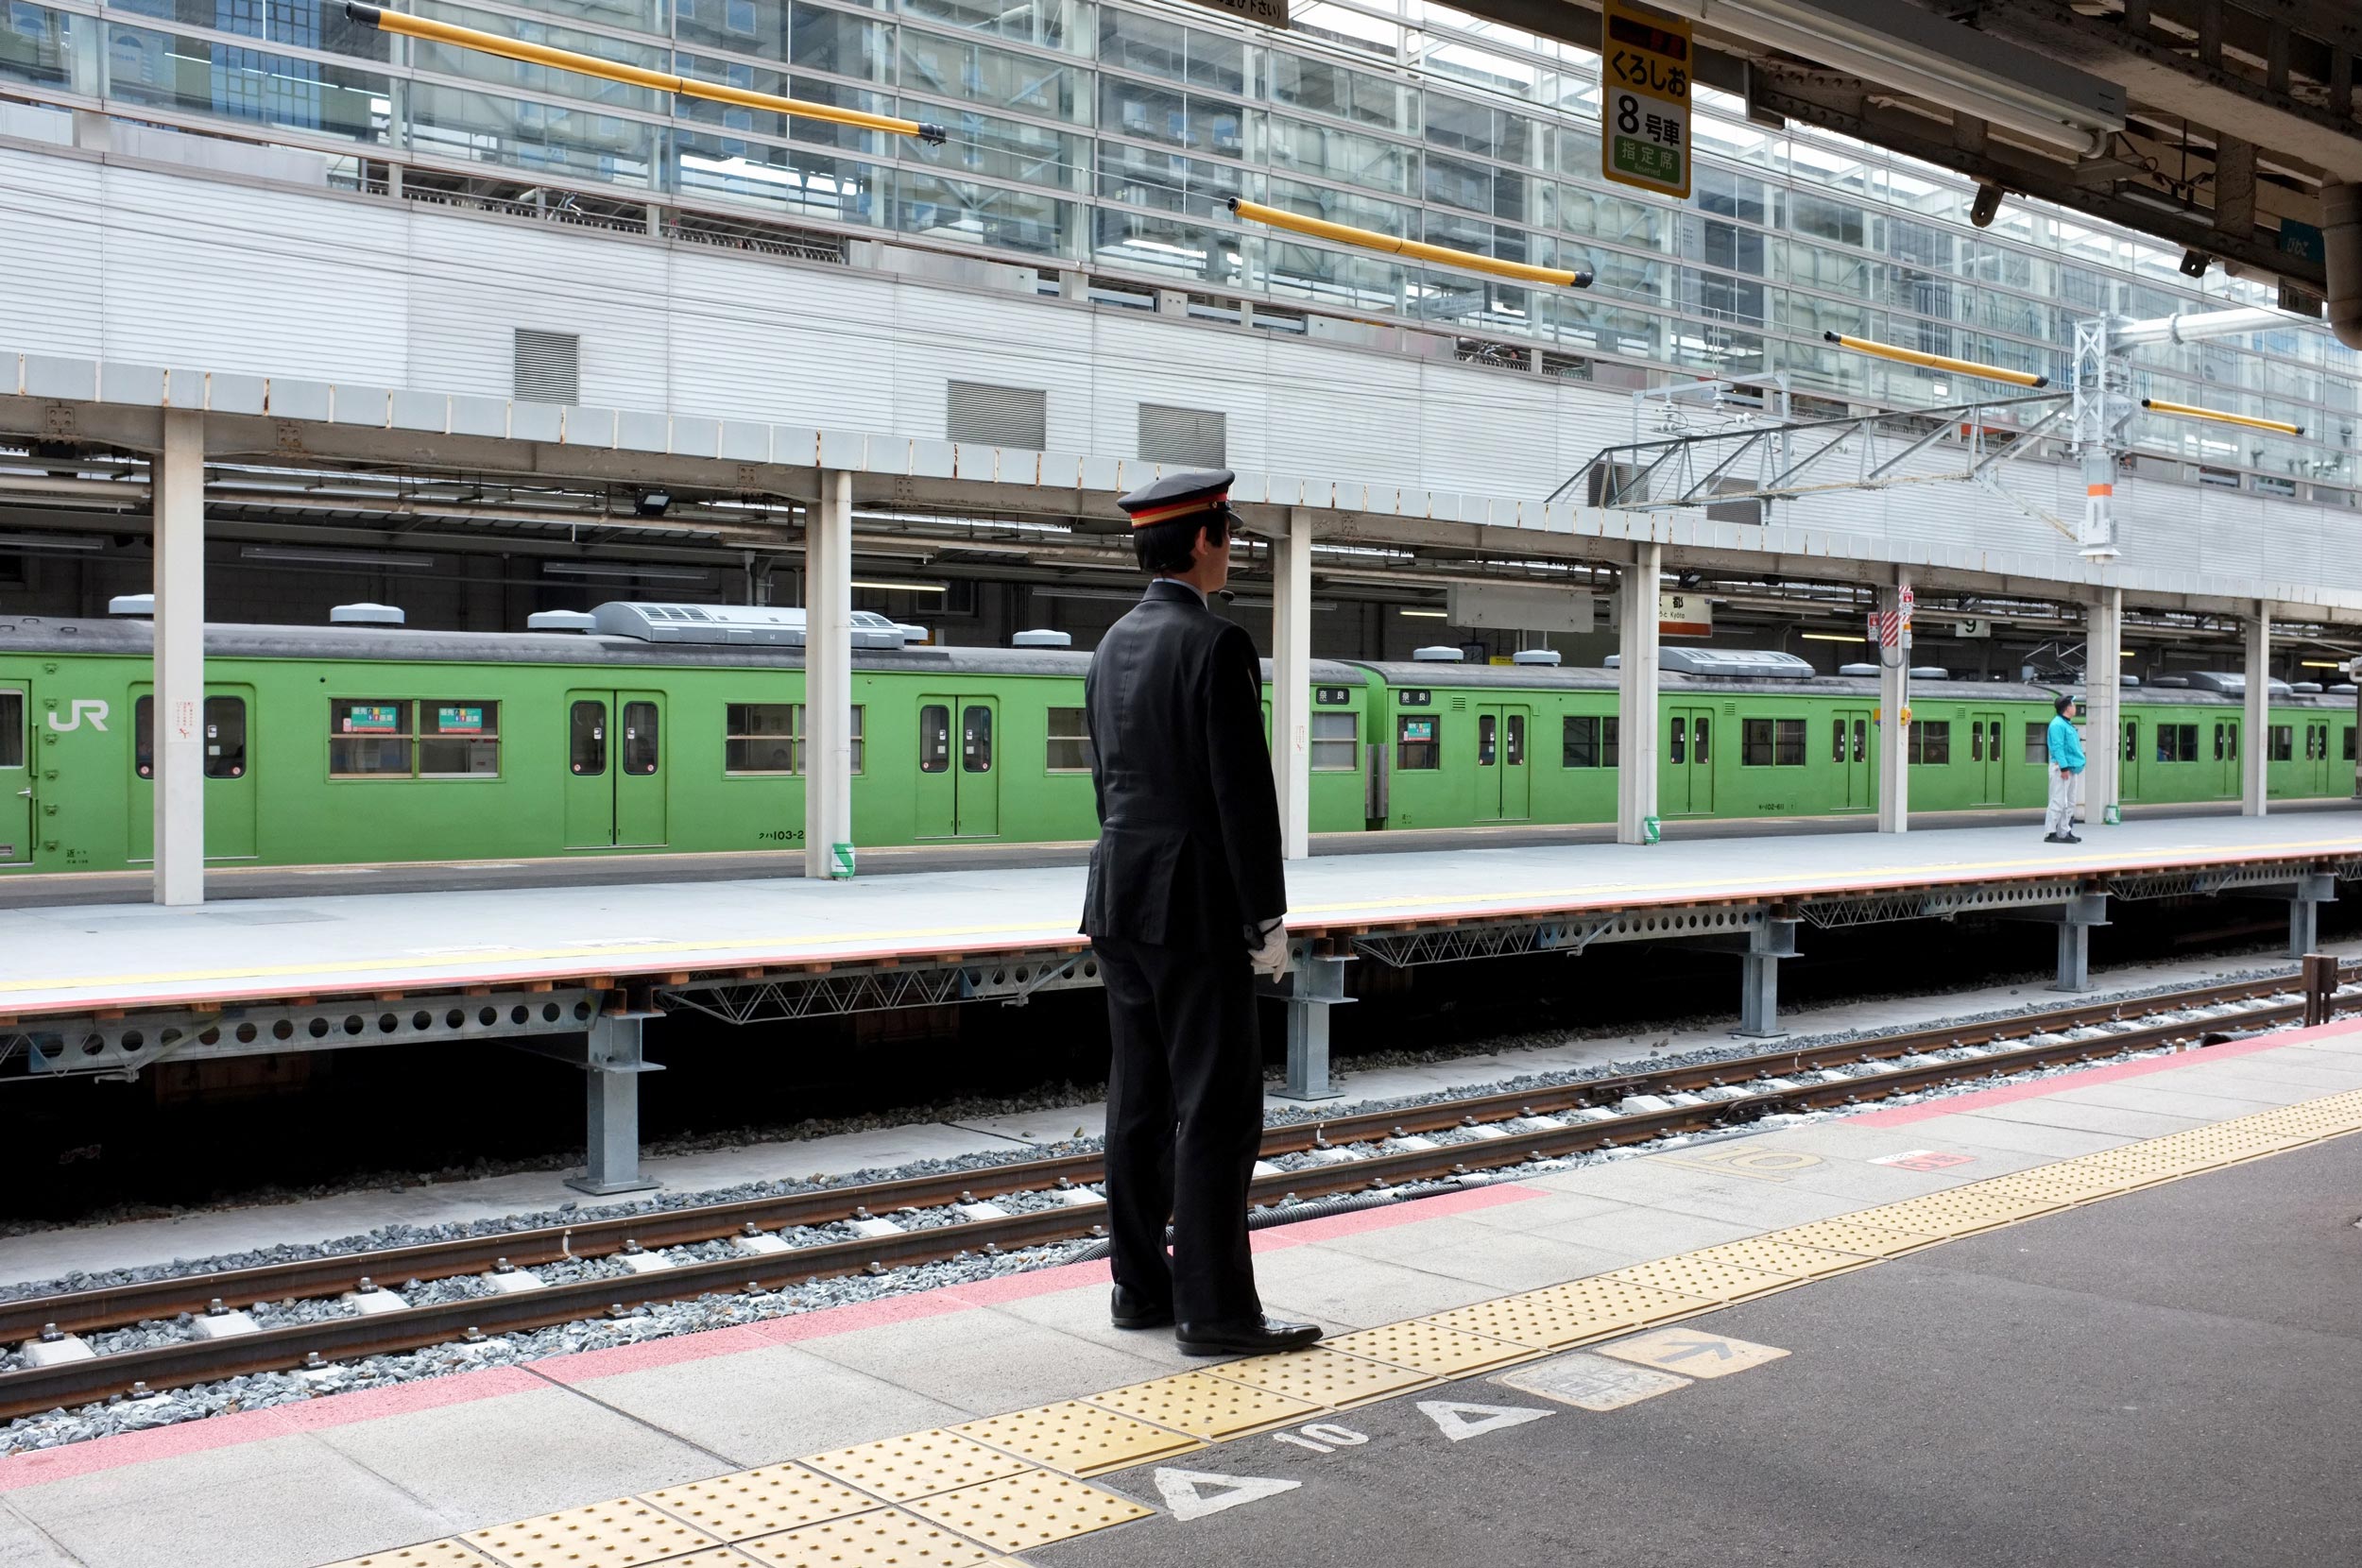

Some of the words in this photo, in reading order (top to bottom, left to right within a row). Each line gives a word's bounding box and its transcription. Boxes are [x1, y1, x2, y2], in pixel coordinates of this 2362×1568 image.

[1612, 50, 1686, 97] くろしお
[1622, 141, 1673, 170] 指定席
[1635, 163, 1661, 177] Reserved
[1966, 619, 1977, 633] 9
[1319, 690, 1344, 702] 奈良
[1402, 692, 1426, 703] 奈良
[48, 699, 109, 731] JR
[1273, 1423, 1370, 1454] 10
